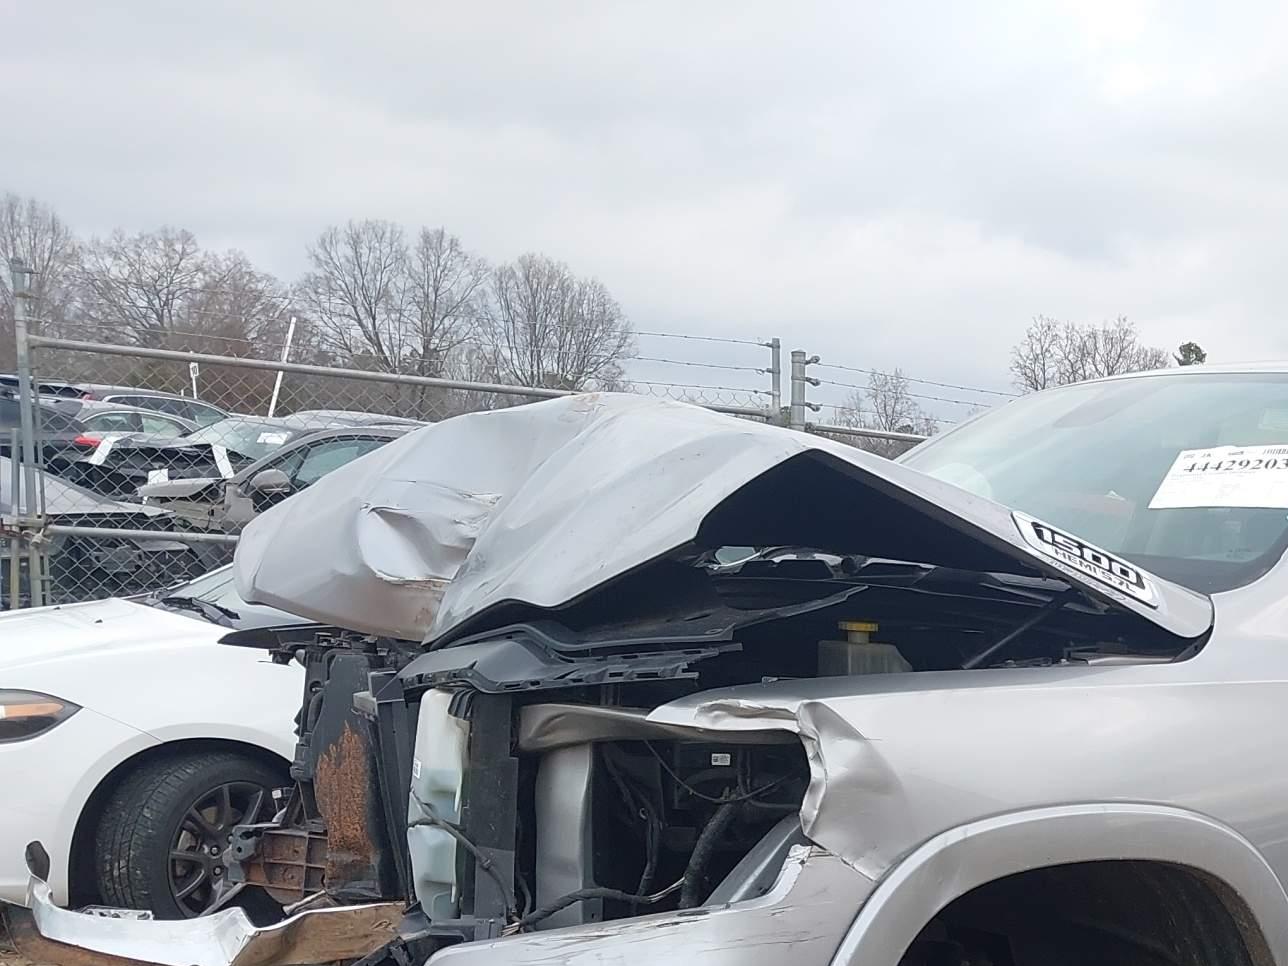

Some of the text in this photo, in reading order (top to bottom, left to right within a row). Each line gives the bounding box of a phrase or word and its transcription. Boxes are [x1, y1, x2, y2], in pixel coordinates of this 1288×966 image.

[1032, 523, 1143, 587] 1500
[1054, 547, 1136, 594] HEMI 5.7L
